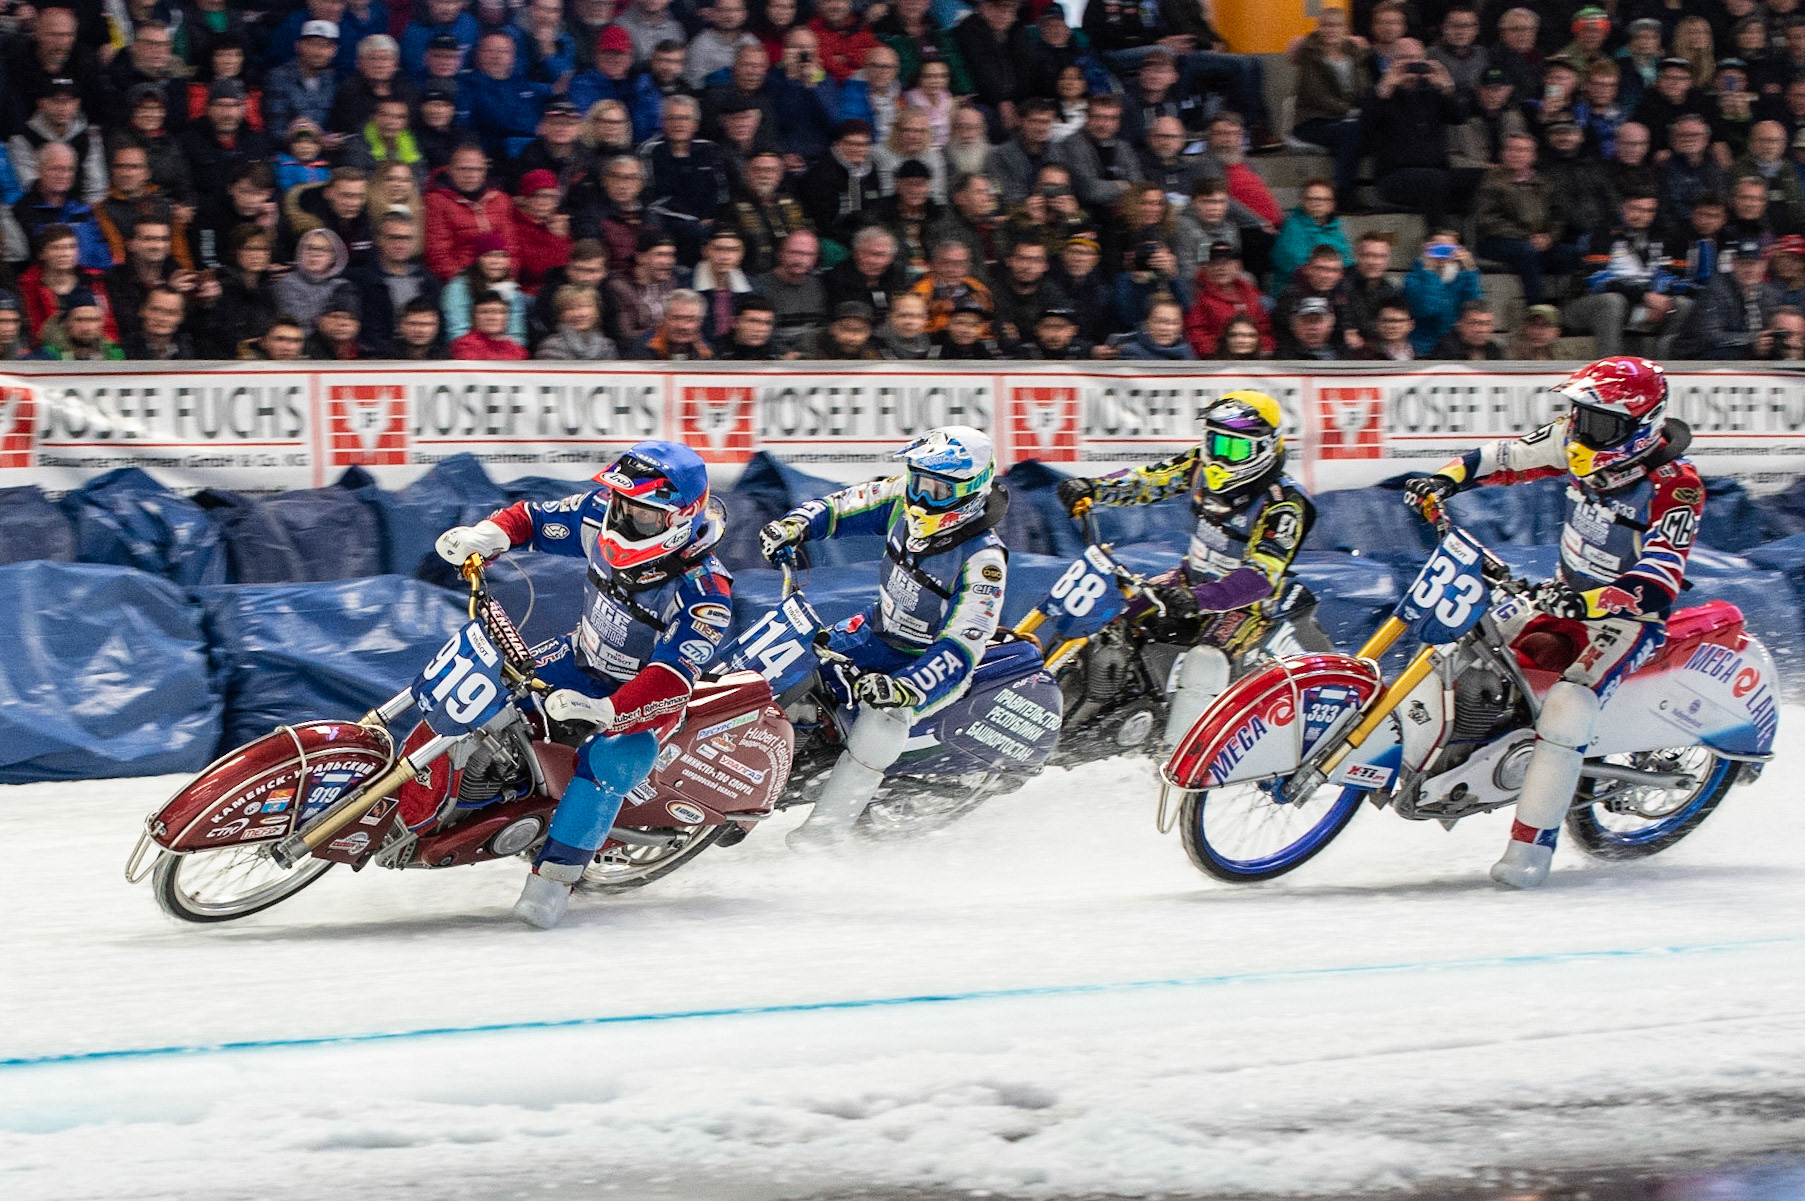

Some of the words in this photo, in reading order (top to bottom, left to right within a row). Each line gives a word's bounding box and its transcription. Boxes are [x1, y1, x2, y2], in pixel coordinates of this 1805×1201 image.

[41, 386, 158, 439] JOSEF
[176, 385, 306, 438] FUCHS
[413, 384, 531, 436] JOSEF
[538, 385, 660, 436] FUCHS
[759, 386, 863, 436] JOSEF
[876, 386, 990, 436] FUCHS
[1082, 388, 1181, 435] JOSEF
[1385, 386, 1484, 433] JOSEF
[1493, 386, 1569, 433] FUCH
[1676, 386, 1764, 432] JOSEF
[965, 461, 994, 494] 100
[1611, 499, 1637, 520] 333
[973, 584, 994, 595] elf
[1050, 559, 1107, 617] 88
[1407, 549, 1484, 628] 33
[489, 600, 529, 662] RENTHAL
[594, 591, 633, 631] ICE
[471, 632, 490, 657] TISSOT
[738, 610, 806, 681] 114
[1684, 642, 1743, 684] MEGA
[423, 632, 497, 724] 919
[912, 650, 964, 692] UFA
[644, 695, 691, 713] Reischmann
[985, 706, 1046, 742] РЕСПУБЛИКИ
[993, 688, 1063, 731] ПРАВИТЕЛЬСТВО
[1307, 703, 1340, 723] 333
[743, 727, 780, 749] Hubert
[965, 721, 1035, 762] БАШКОРТОСТАН
[1209, 715, 1268, 783] MEGA
[308, 787, 343, 804] 919
